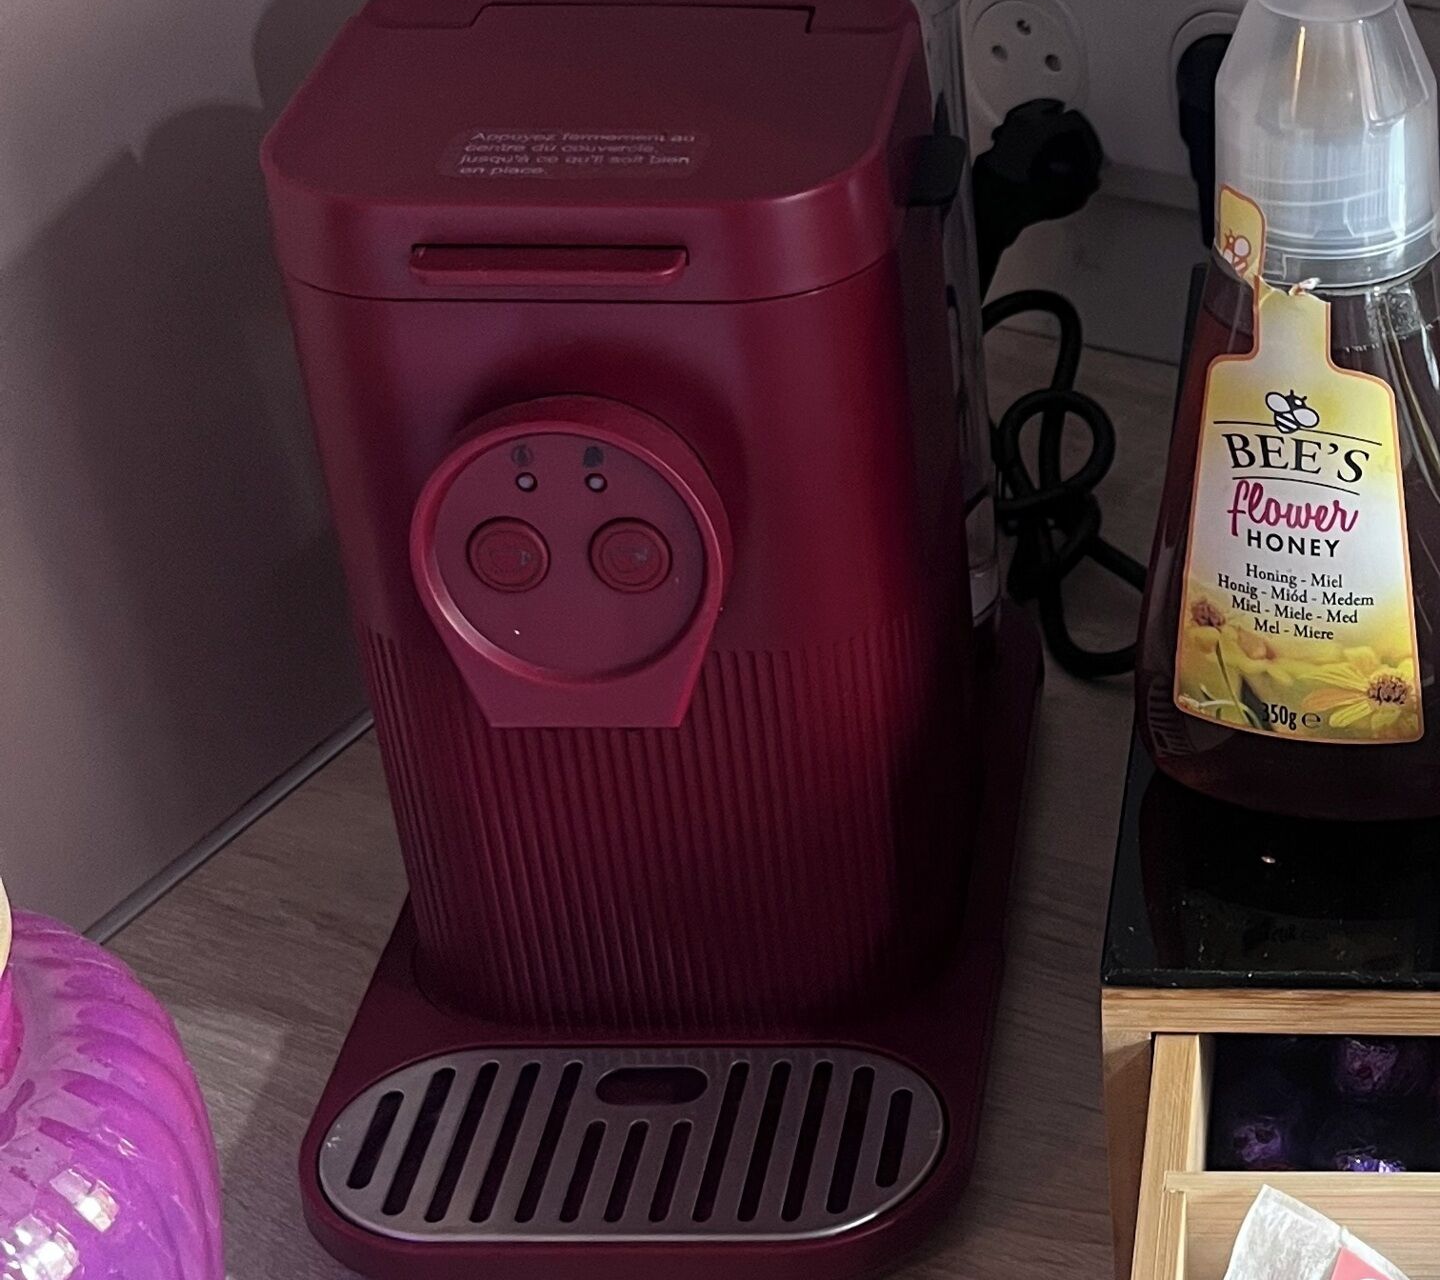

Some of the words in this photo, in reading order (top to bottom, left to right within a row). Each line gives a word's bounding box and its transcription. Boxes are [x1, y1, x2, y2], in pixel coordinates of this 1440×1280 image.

[464, 143, 527, 153] centre
[531, 143, 558, 153] du
[471, 132, 556, 144] Appuyez
[561, 131, 666, 143] fermement
[671, 134, 696, 143] au
[459, 166, 485, 175] en
[536, 155, 559, 164] ce
[608, 154, 644, 164] soit
[649, 154, 691, 165] bien
[1227, 479, 1359, 537] flower
[1247, 528, 1340, 558] HONEY
[1246, 562, 1298, 589] Honing
[1311, 573, 1343, 589] Miel
[1217, 573, 1259, 600] Honig
[1271, 585, 1308, 604] Miód
[1321, 591, 1375, 607] Medem
[1231, 595, 1262, 615] Miel
[1274, 604, 1314, 622] Miele
[1326, 609, 1359, 624] Med
[1254, 617, 1281, 635] Mel
[1293, 623, 1335, 641] Miere
[1261, 702, 1297, 731] 350g
